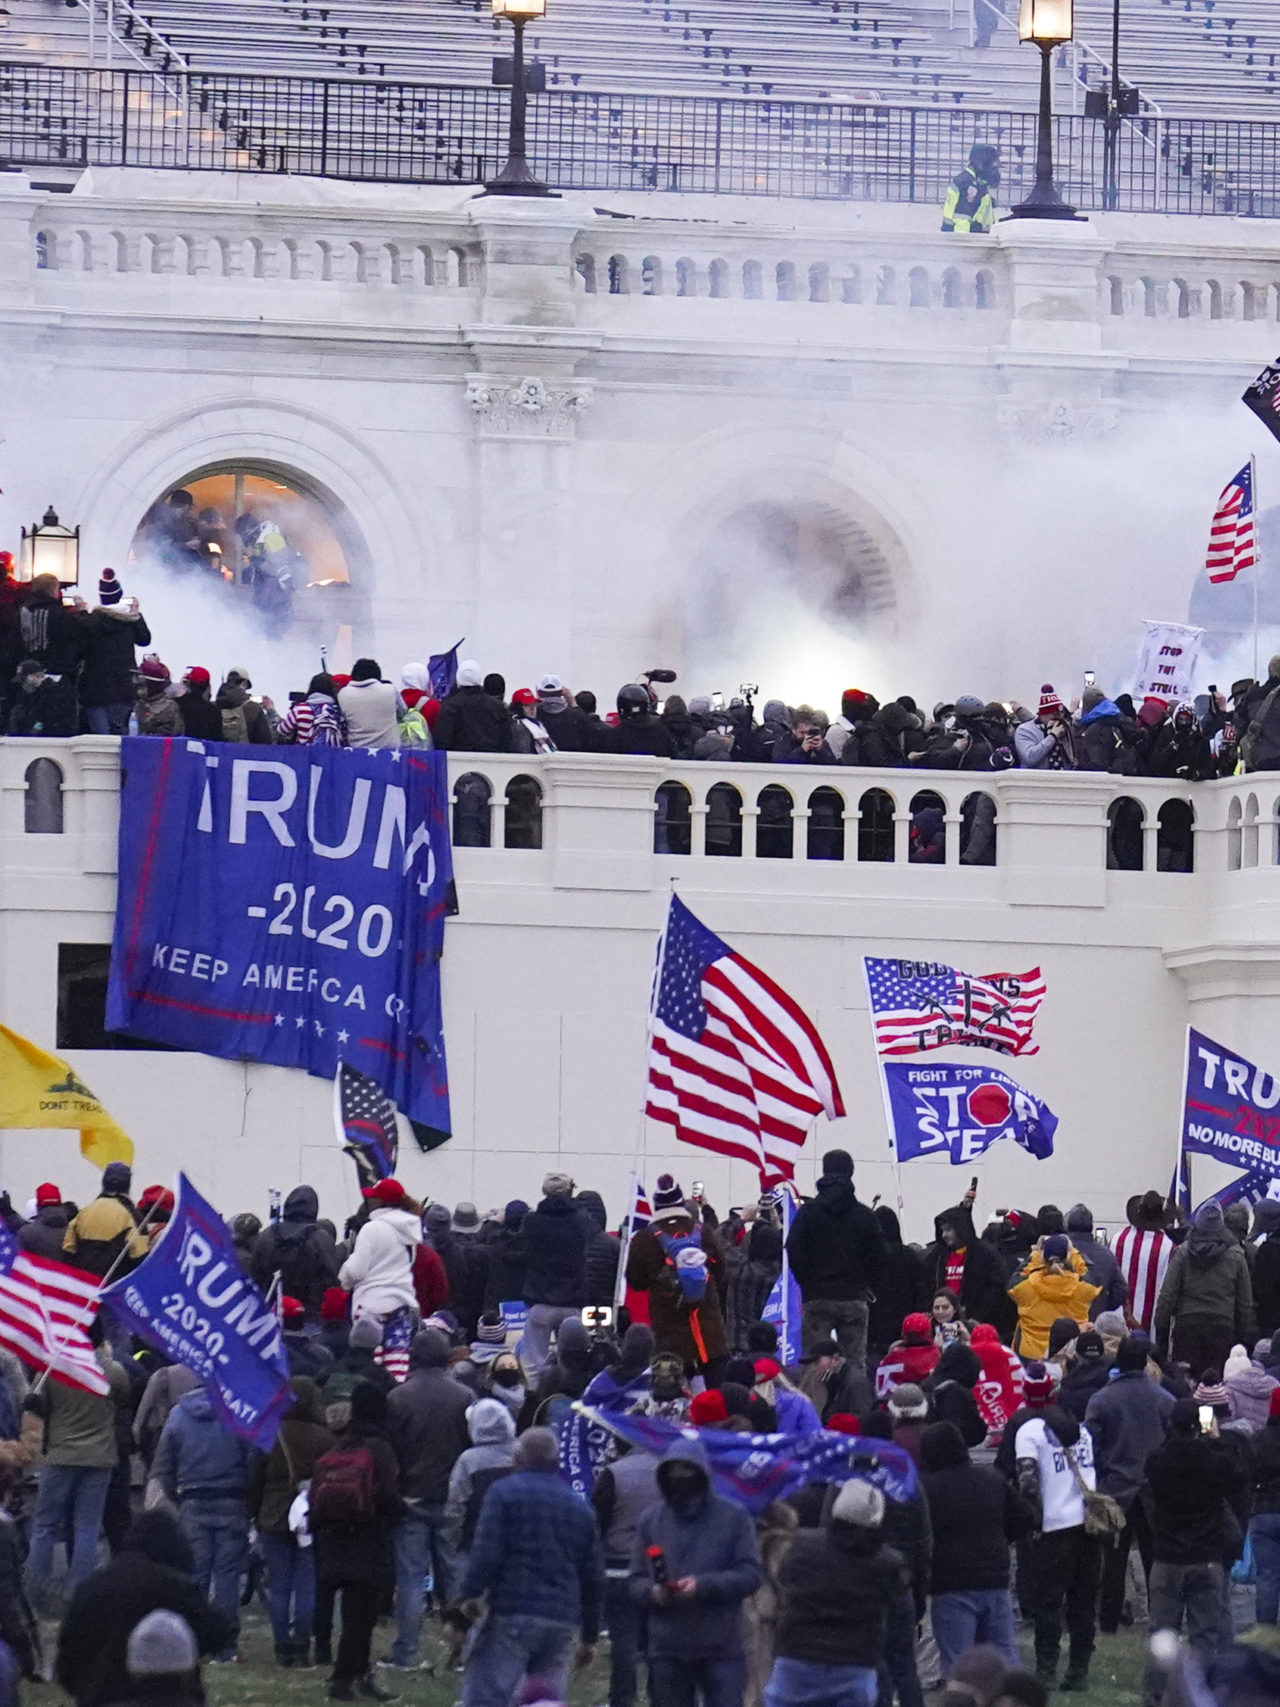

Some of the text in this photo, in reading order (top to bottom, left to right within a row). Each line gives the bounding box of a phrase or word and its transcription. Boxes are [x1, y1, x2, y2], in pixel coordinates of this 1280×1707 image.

[1159, 645, 1183, 657] STOP
[152, 942, 229, 983] KEEP
[242, 963, 367, 1011] AMERCA
[908, 1070, 948, 1083] FIGHT
[955, 1069, 983, 1081] FOR
[1188, 1122, 1214, 1144] NO
[1213, 1132, 1262, 1160] MORE
